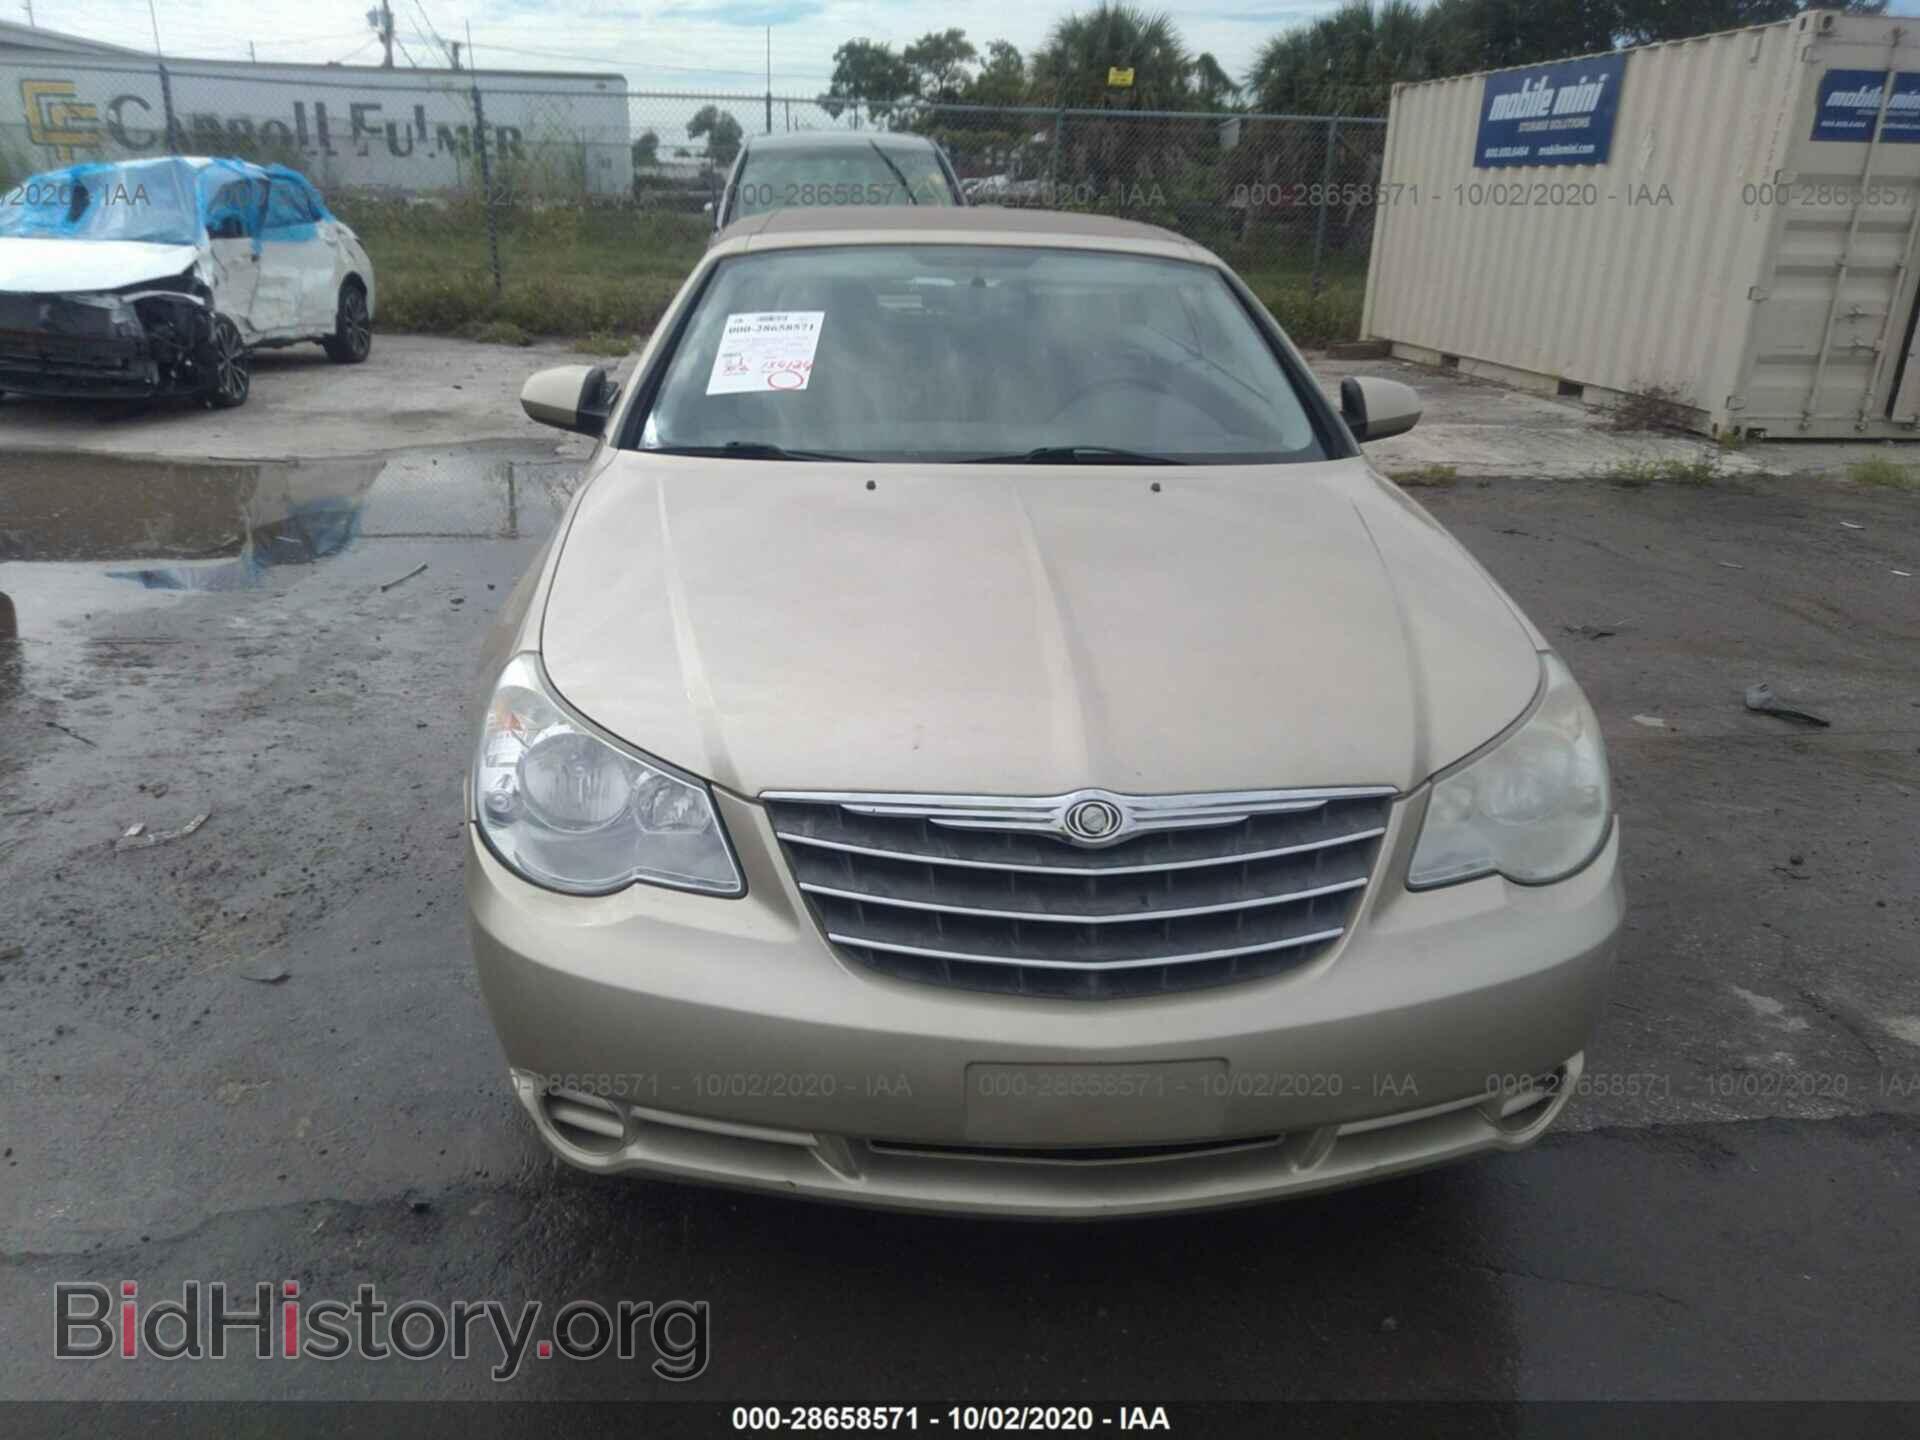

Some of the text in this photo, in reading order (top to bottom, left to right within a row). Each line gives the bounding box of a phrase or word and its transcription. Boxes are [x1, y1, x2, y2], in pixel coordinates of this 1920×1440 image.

[1487, 73, 1609, 121] mobile mini
[1825, 85, 1884, 108] mobil
